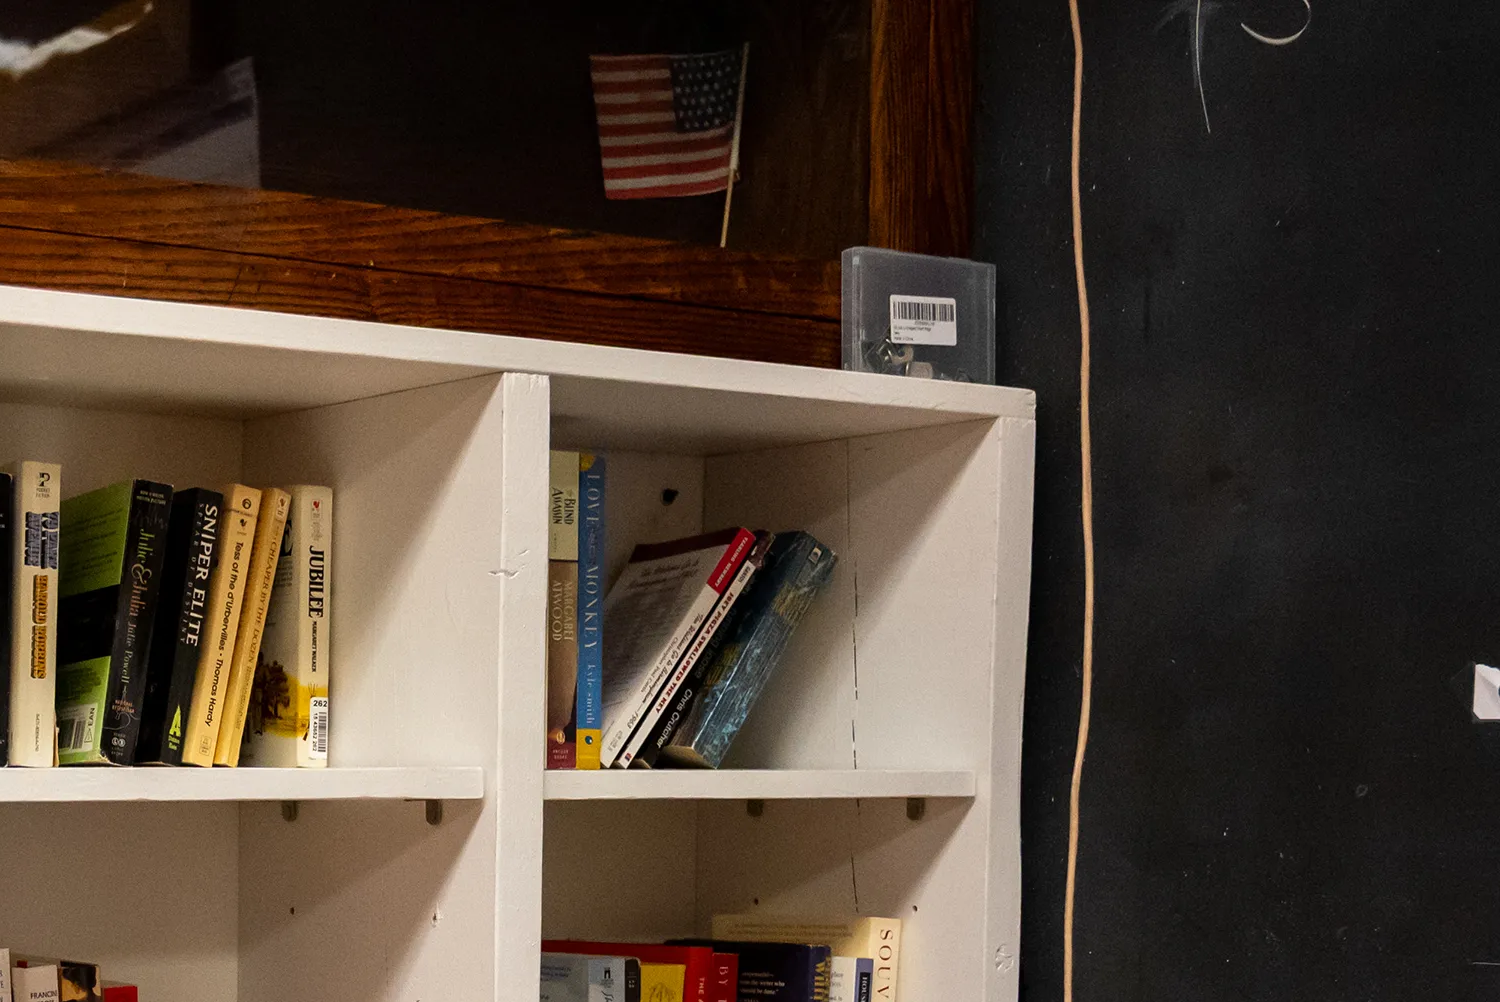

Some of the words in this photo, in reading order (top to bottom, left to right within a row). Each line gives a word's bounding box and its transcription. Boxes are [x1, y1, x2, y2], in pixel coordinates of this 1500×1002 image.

[195, 504, 218, 581] SNIPER
[308, 545, 324, 618] JUBILEE
[721, 592, 735, 609] JOEY
[186, 587, 206, 647] ELITE
[704, 610, 722, 635] PIGZA
[676, 635, 707, 683] SWALLOWED
[211, 659, 224, 696] Thomas
[665, 682, 677, 700] THE
[205, 698, 217, 727] Hardy
[655, 698, 667, 714] KEY
[676, 689, 693, 711] Chris
[657, 712, 679, 749] Crutcher
[718, 966, 729, 986] BY
